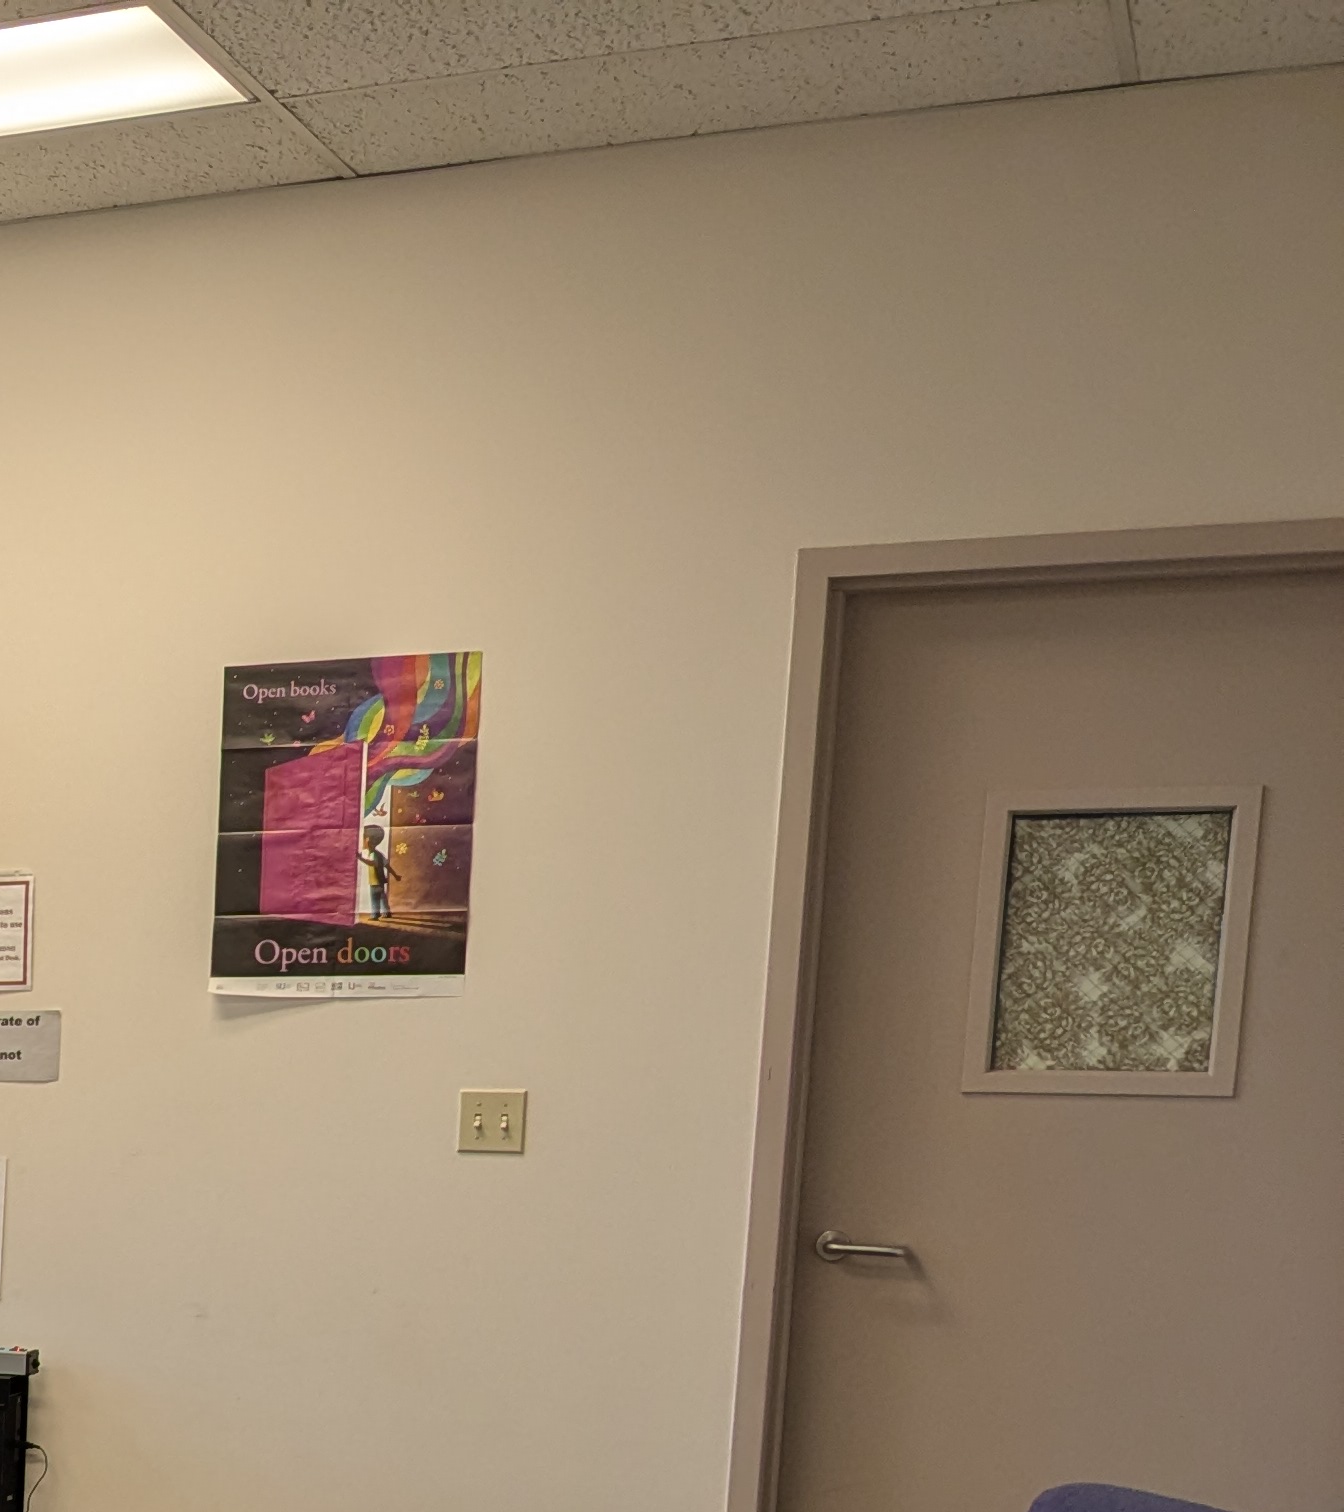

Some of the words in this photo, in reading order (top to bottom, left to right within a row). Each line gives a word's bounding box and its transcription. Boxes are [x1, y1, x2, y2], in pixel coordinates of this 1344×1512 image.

[242, 684, 286, 704] Open
[290, 680, 337, 697] books
[254, 938, 328, 973] Open
[337, 937, 411, 965] doors
[26, 1015, 41, 1026] of
[0, 1049, 22, 1060] not
